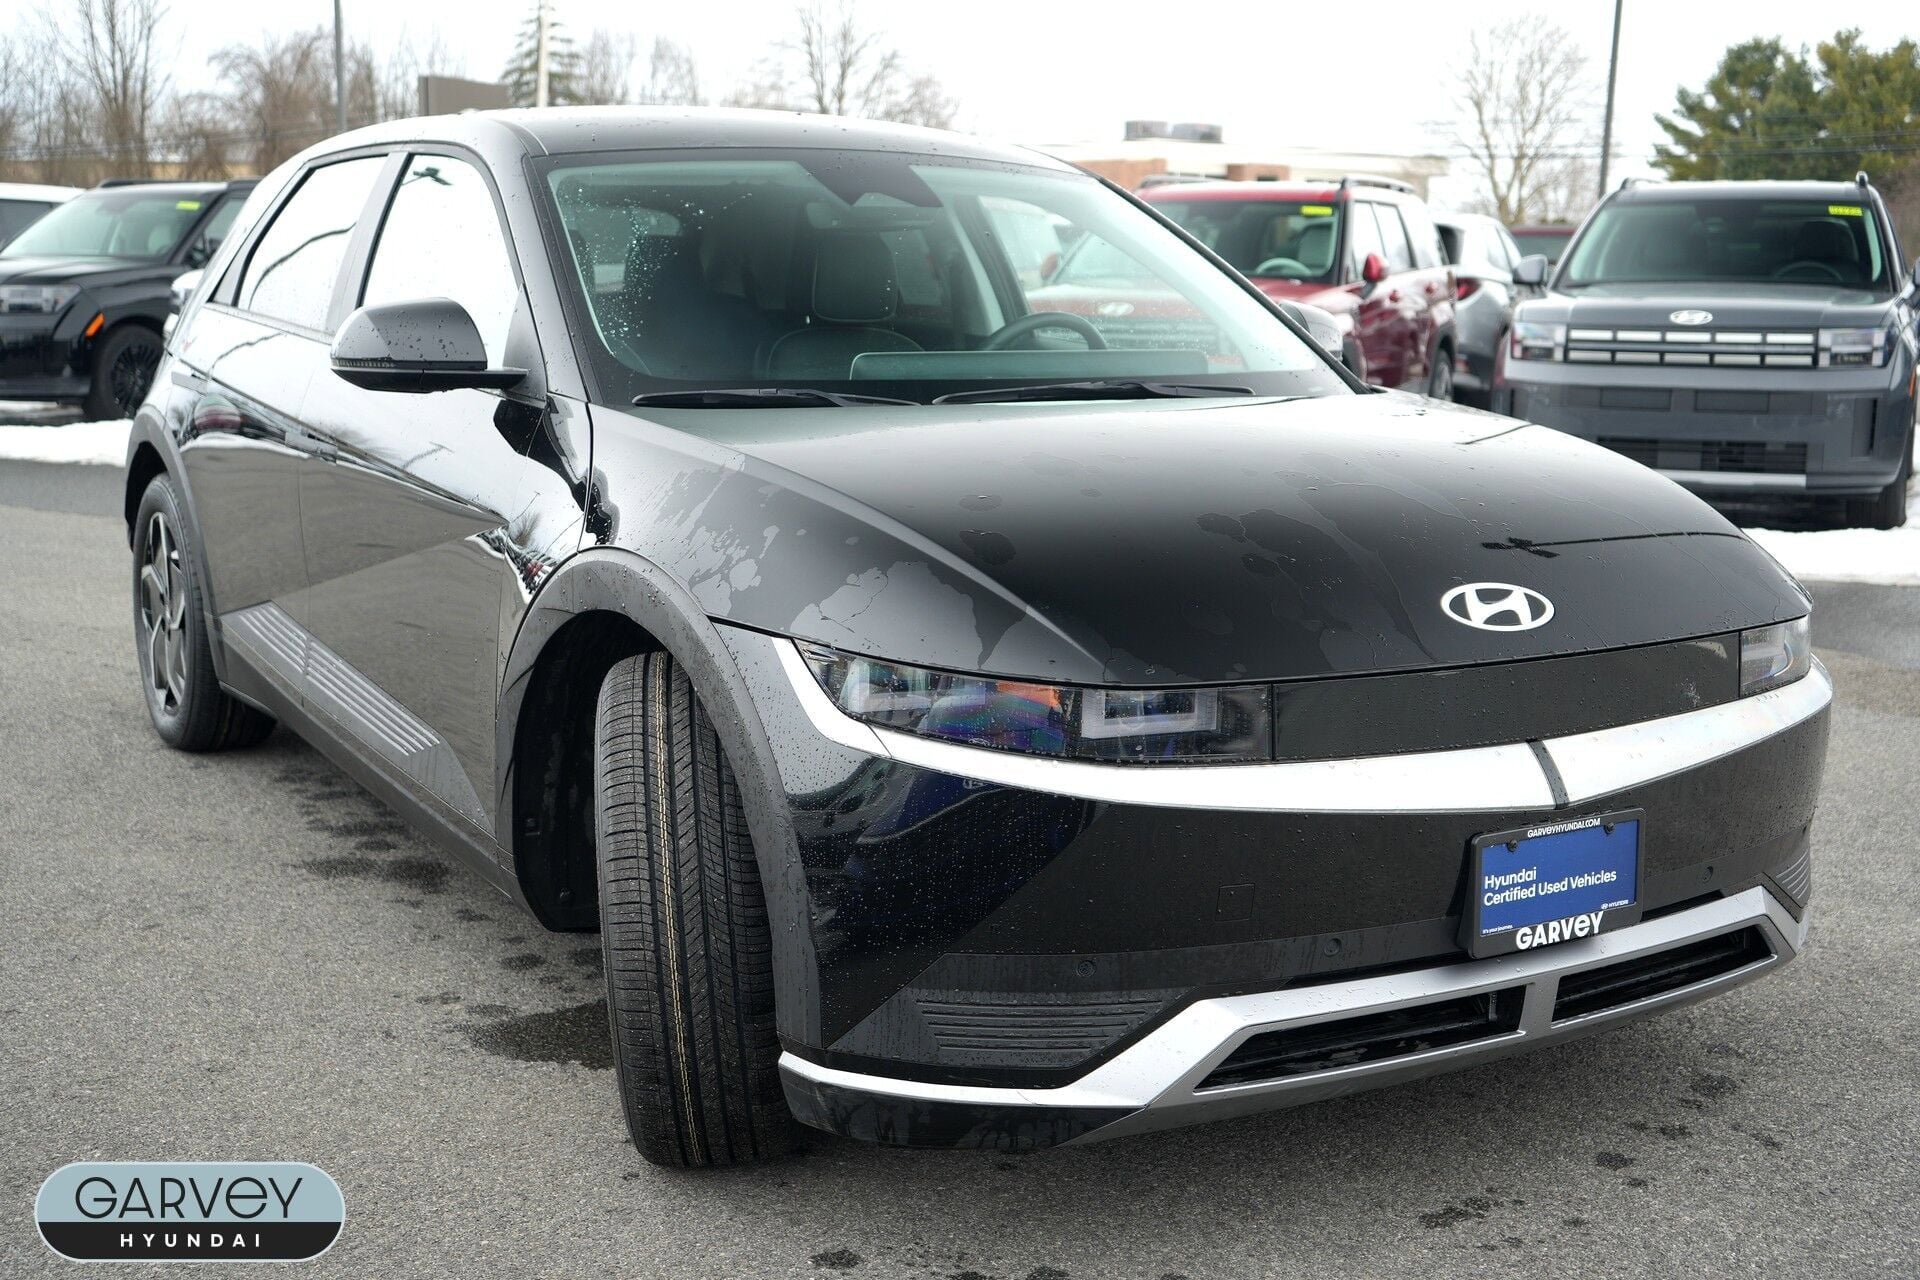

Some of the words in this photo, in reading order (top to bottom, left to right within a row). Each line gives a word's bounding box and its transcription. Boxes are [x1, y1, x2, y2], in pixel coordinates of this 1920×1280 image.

[1483, 883, 1536, 906] Certified
[1538, 878, 1568, 896] Used
[1569, 870, 1617, 889] Vehicles
[1484, 867, 1537, 890] Hyundai
